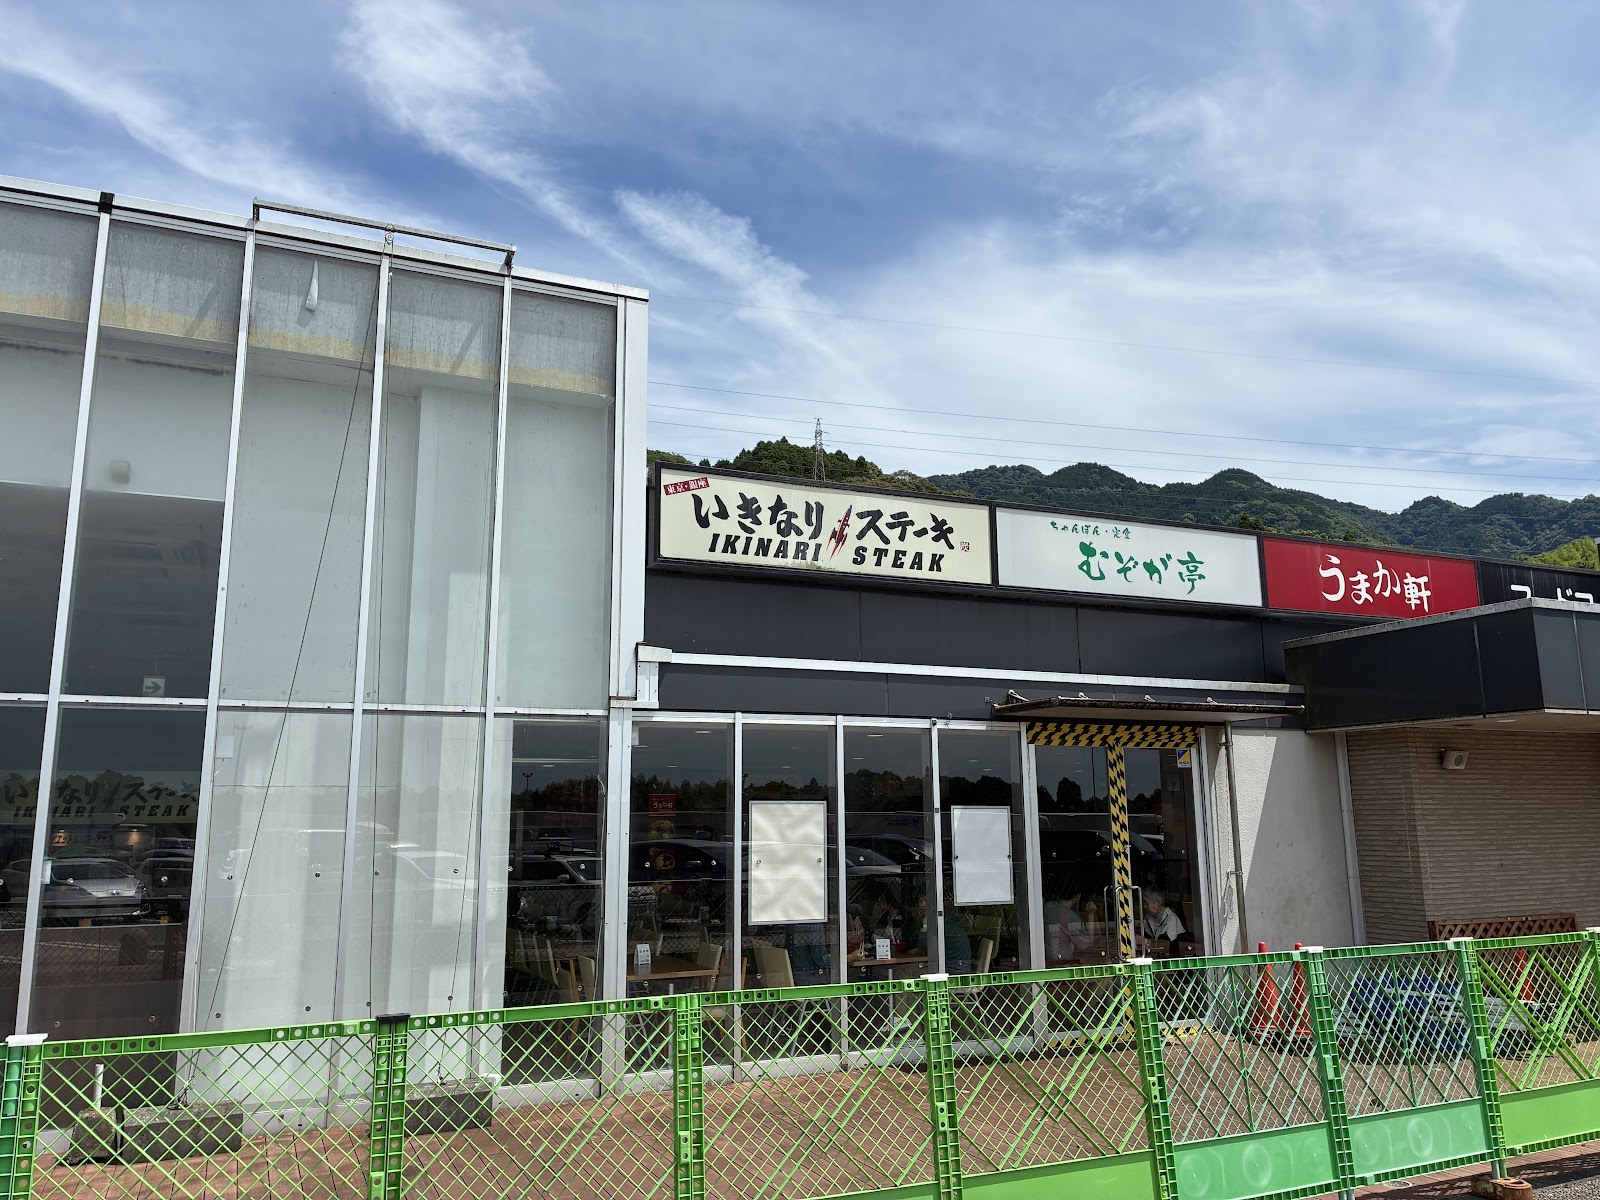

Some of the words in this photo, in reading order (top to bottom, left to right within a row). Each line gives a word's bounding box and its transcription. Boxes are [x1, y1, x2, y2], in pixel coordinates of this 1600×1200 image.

[691, 492, 825, 540] いきなり
[856, 508, 954, 550] ステーキ
[708, 533, 823, 562] IKINARI
[852, 545, 945, 572] STEAK
[1318, 553, 1432, 613] うまか軒
[118, 804, 190, 817] STEAK
